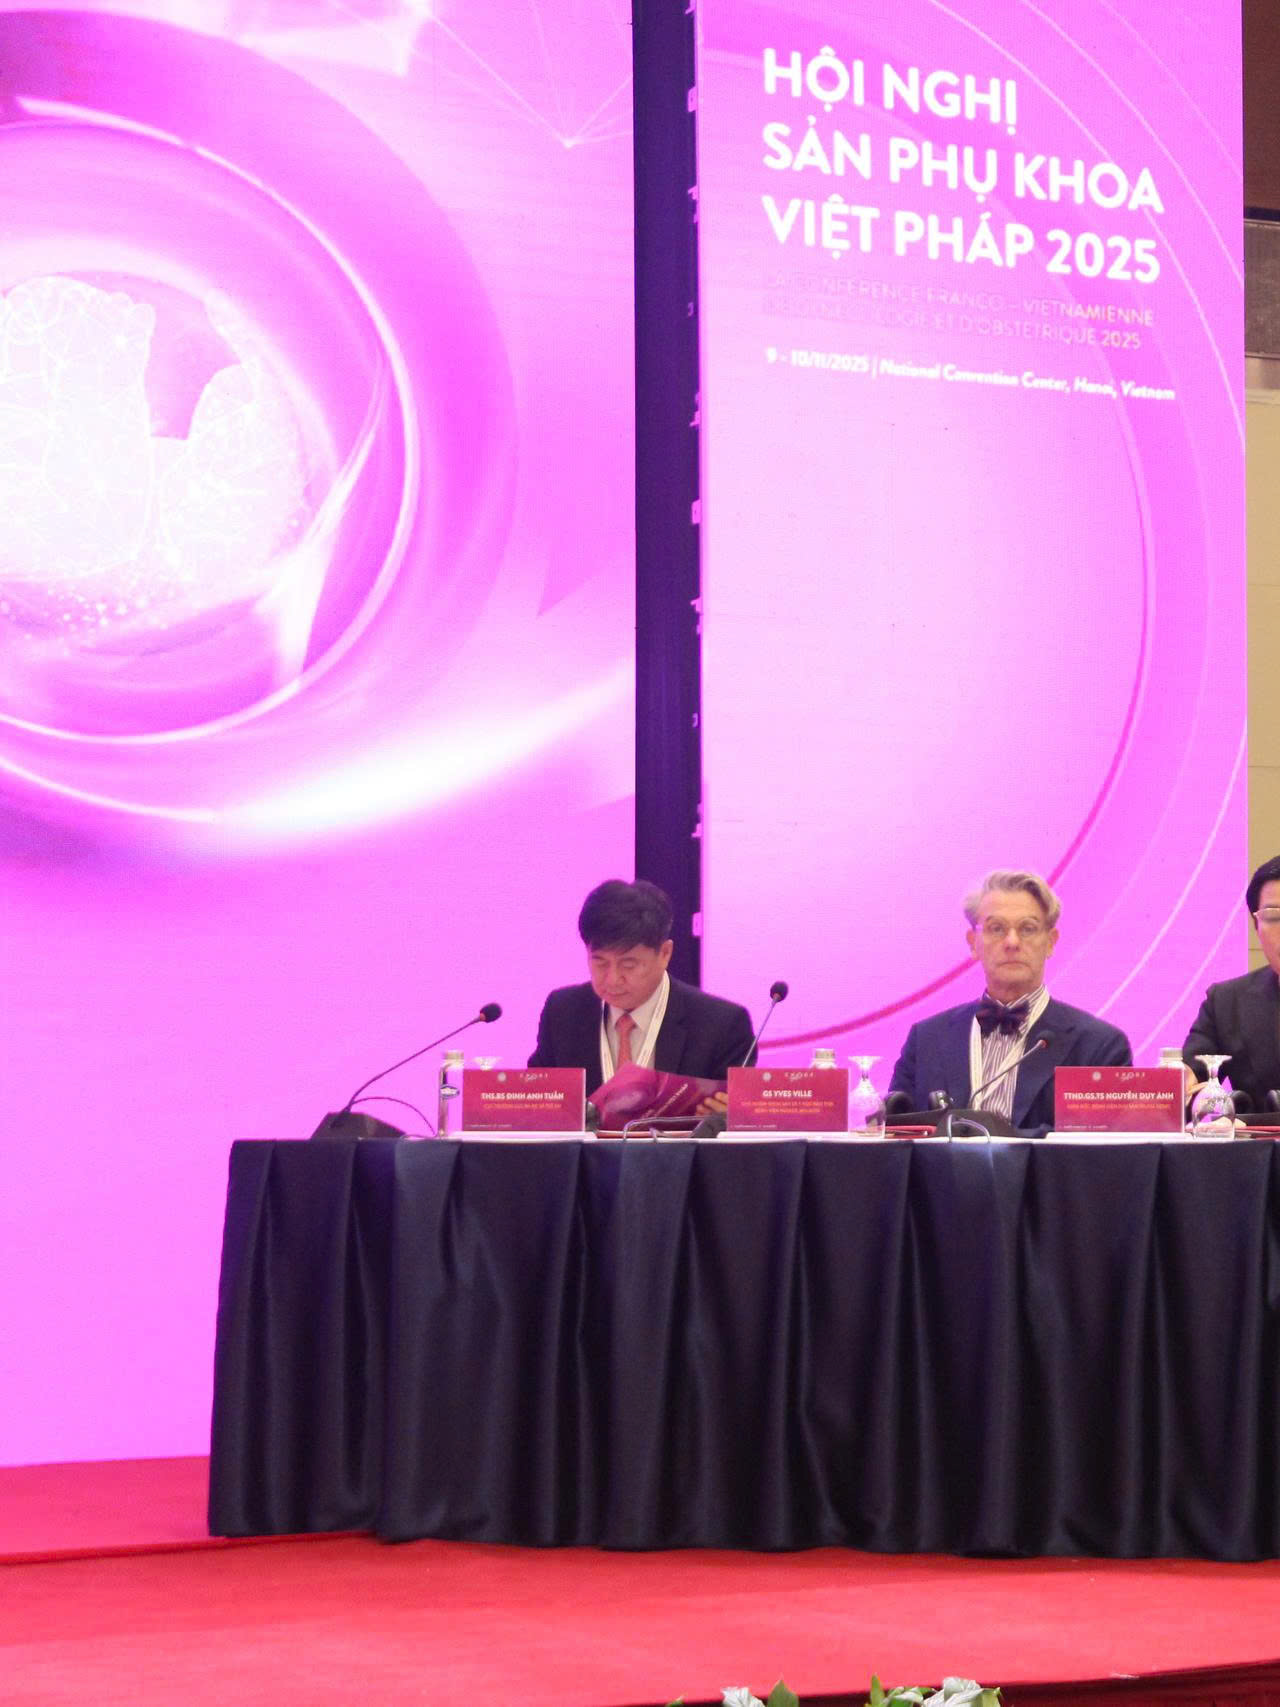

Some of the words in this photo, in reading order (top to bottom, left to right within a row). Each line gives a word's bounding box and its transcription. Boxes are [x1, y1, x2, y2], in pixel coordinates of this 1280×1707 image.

[763, 44, 866, 112] HỘI
[882, 63, 1018, 136] NGHỊ
[761, 114, 872, 181] SẢN
[889, 136, 999, 203] PHỤ
[1013, 152, 1166, 214] KHOA
[761, 192, 881, 260] VIỆT
[893, 210, 1035, 268] PHÁP
[1045, 229, 1162, 284] 2025
[1101, 329, 1142, 351] 2025
[791, 350, 869, 373] 10/11/2025
[880, 359, 941, 380] National
[944, 363, 1019, 387] Convention
[1120, 380, 1175, 401] Vietnam
[527, 1092, 543, 1101] ANH
[762, 1090, 773, 1098] GS
[774, 1090, 792, 1098] YVES
[793, 1090, 813, 1098] VILLE
[1139, 1092, 1155, 1101] DUY
